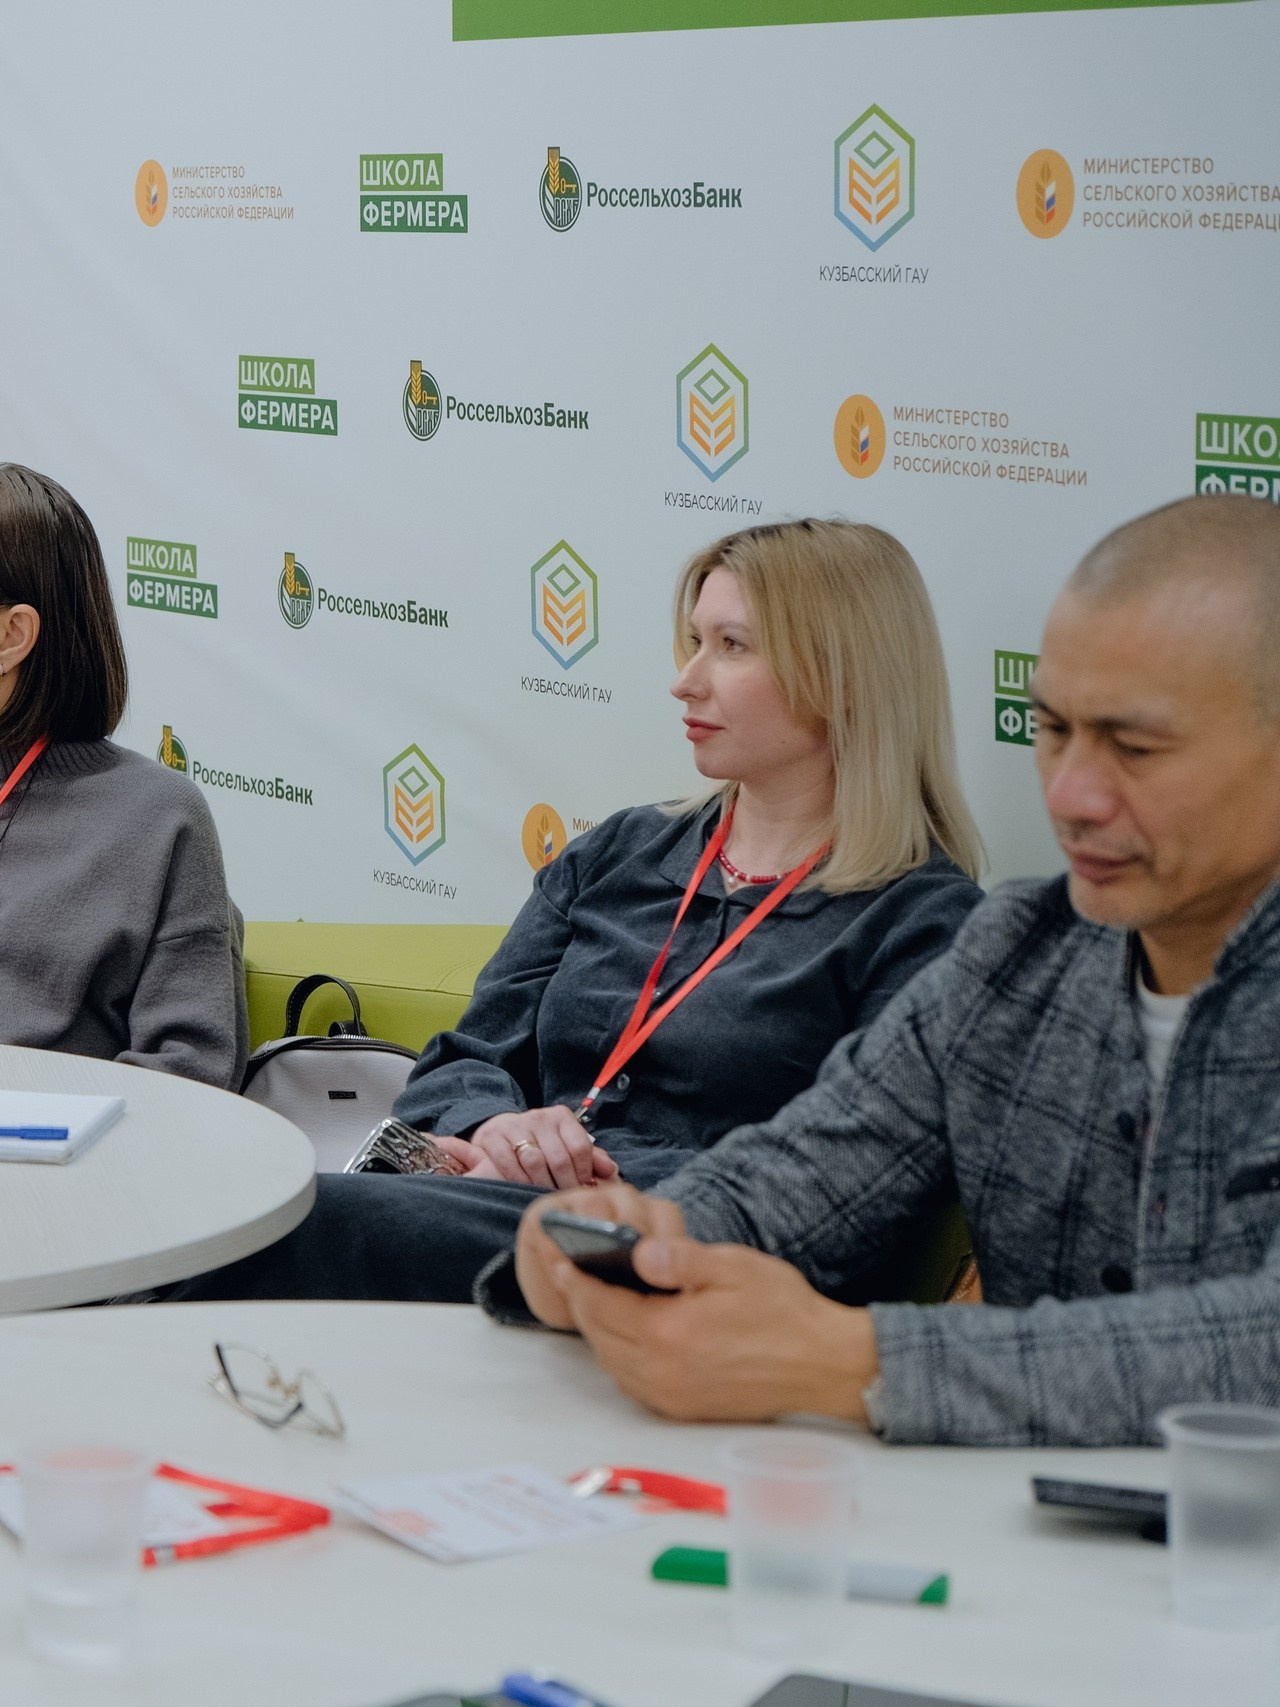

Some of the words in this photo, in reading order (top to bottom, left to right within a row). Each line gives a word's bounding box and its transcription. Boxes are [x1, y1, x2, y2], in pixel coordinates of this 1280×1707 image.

[172, 166, 245, 179] МИНИСТЕРСТВО
[363, 160, 440, 185] ШКОЛА
[1083, 157, 1214, 175] МИНИСТЕРСТВО
[172, 186, 225, 199] СЕЛЬСКОГО
[227, 184, 283, 199] ХОЗЯЙСТВА
[586, 181, 742, 208] РоссельхозБанк
[1083, 185, 1176, 202] СЕЛЬСКОГО
[1182, 182, 1280, 202] ХОЗЯЙСТВА
[172, 204, 234, 219] РОССИЙСКОЙ
[236, 206, 294, 221] ФЕДЕРАЦИИ
[363, 201, 464, 227] ФЕРМЕРА
[1083, 209, 1192, 229] РОССИЙСКОЙ
[1199, 212, 1280, 232] ФЕДЕРАЦ
[819, 265, 902, 283] КУЗБАССКИЙ
[906, 267, 929, 285] ГАУ
[241, 361, 312, 389] ШКОЛА
[241, 399, 335, 430] ФЕРМЕРА
[446, 395, 589, 430] РоссельхозБанк
[893, 406, 1009, 428] МИНИСТЕРСТВО
[893, 431, 976, 453] СЕЛЬСКОГО
[981, 438, 1069, 459] ХОЗЯЙСТВА
[1201, 421, 1280, 458] ШКО
[893, 456, 991, 478] РОССИЙСКОЙ
[996, 464, 1087, 487] ФЕДЕРАЦИИ
[664, 492, 738, 513] КУЗБАССКИЙ
[741, 499, 762, 515] ГАУ
[128, 541, 194, 573] ШКОЛА
[128, 578, 215, 613] ФЕРМЕРА
[318, 587, 448, 628] РоссельхозБанк
[521, 676, 589, 701] КУЗБАССКИЙ
[592, 686, 612, 704] ГАУ
[193, 760, 313, 805] РоссельхозБанк
[373, 869, 436, 895] КУЗБАССКИЙ
[439, 882, 457, 899] ГАУ
